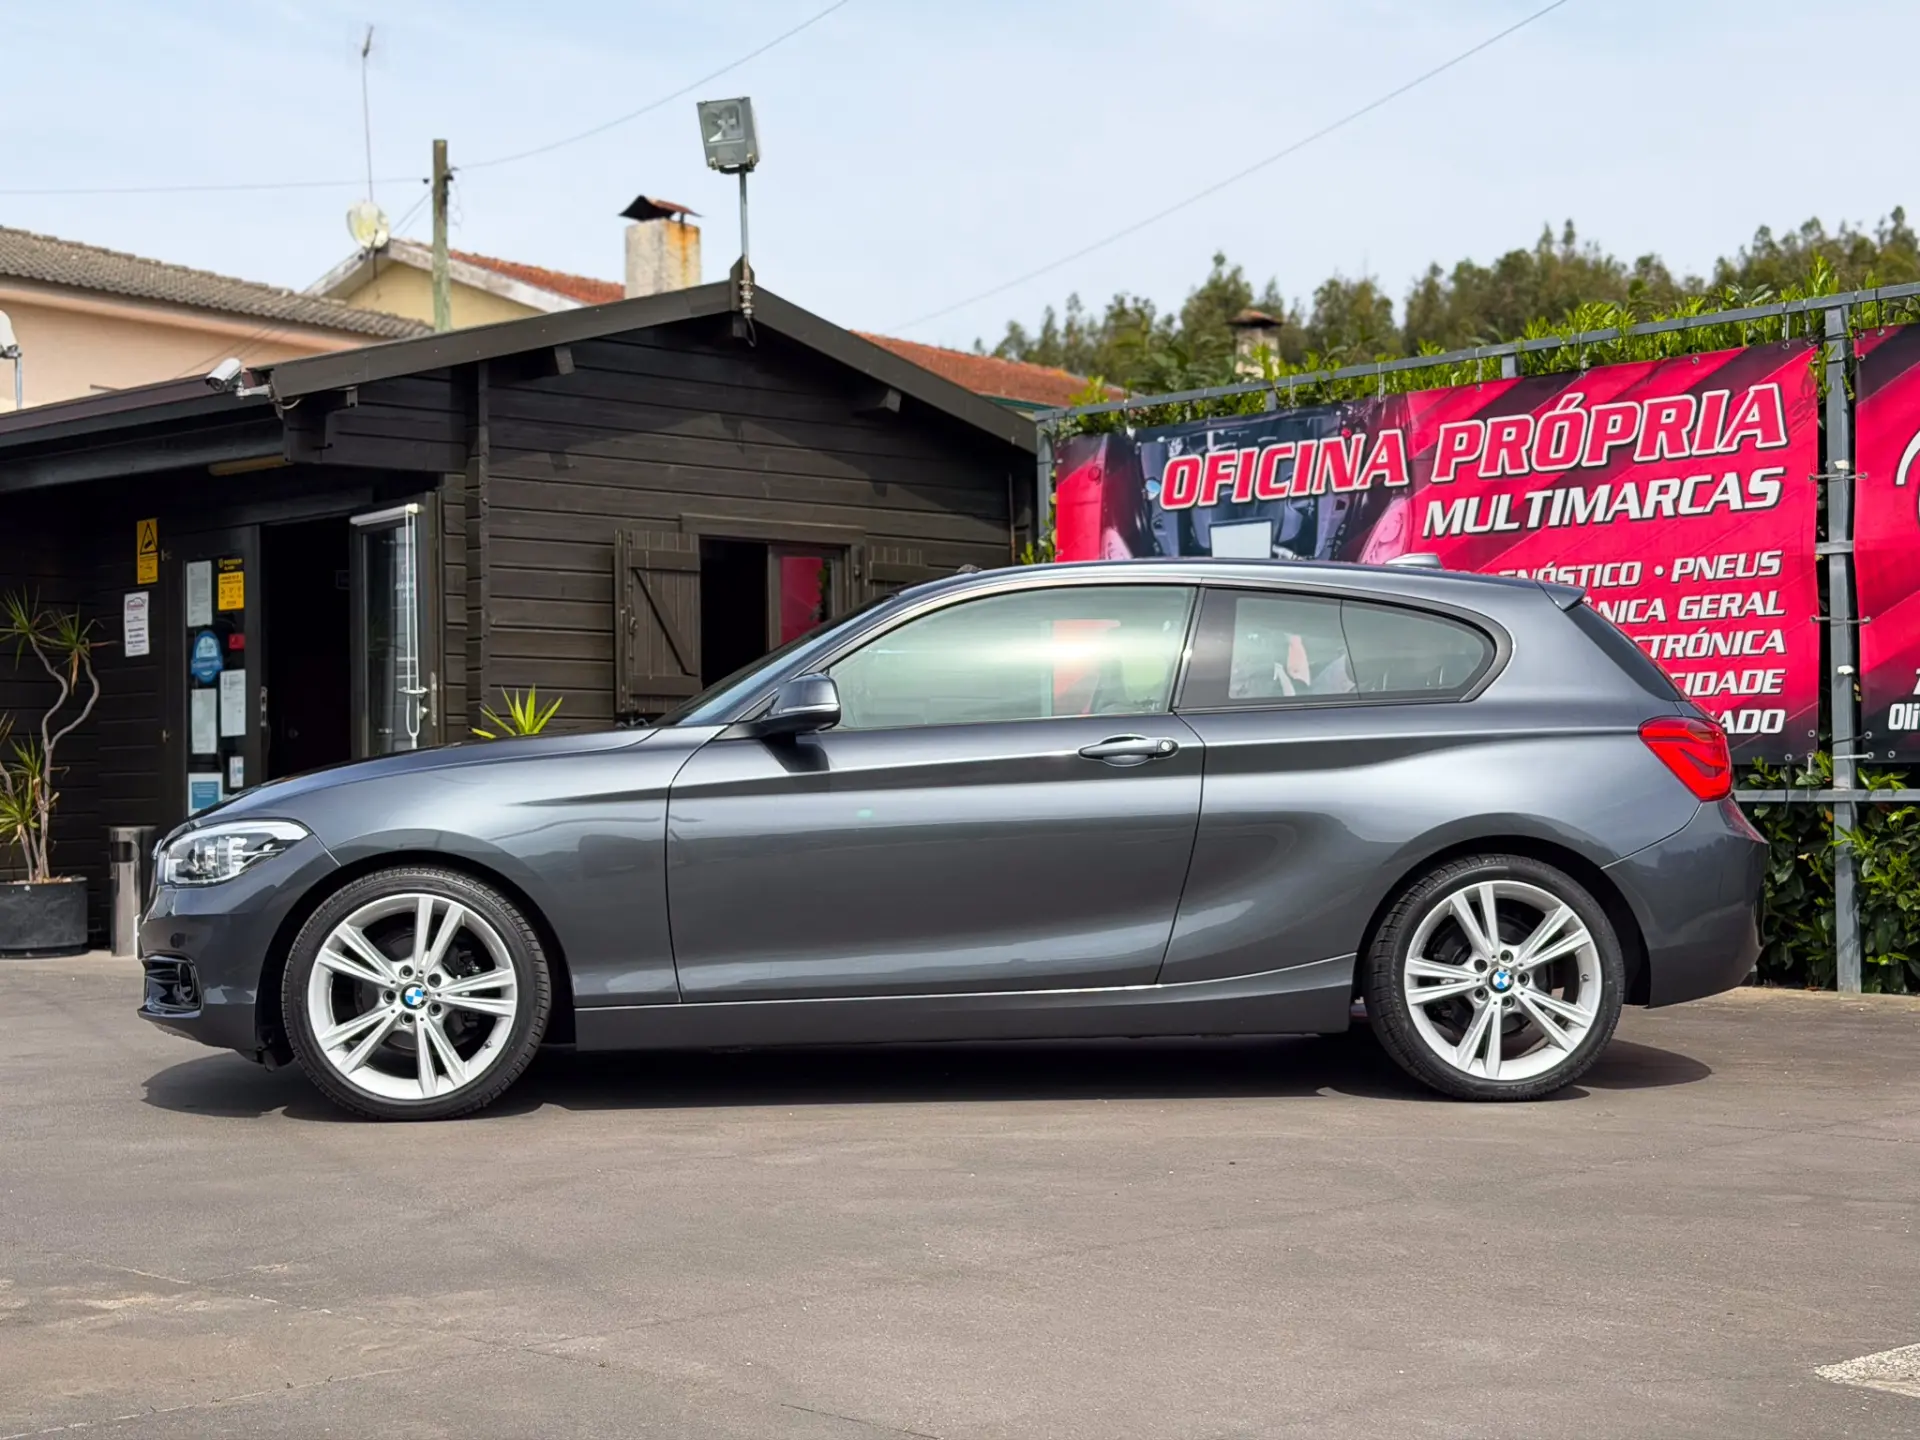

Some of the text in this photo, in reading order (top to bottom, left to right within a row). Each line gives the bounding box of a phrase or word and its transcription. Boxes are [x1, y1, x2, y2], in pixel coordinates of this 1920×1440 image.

[1160, 383, 1787, 510] OFICINA PRÓPRIA
[1422, 467, 1785, 537] MULTIMARCAS
[1671, 550, 1783, 583] PNEUS
[1677, 591, 1785, 621] GERAL
[1711, 709, 1786, 734] ADO
[1888, 703, 1920, 730] Oli
